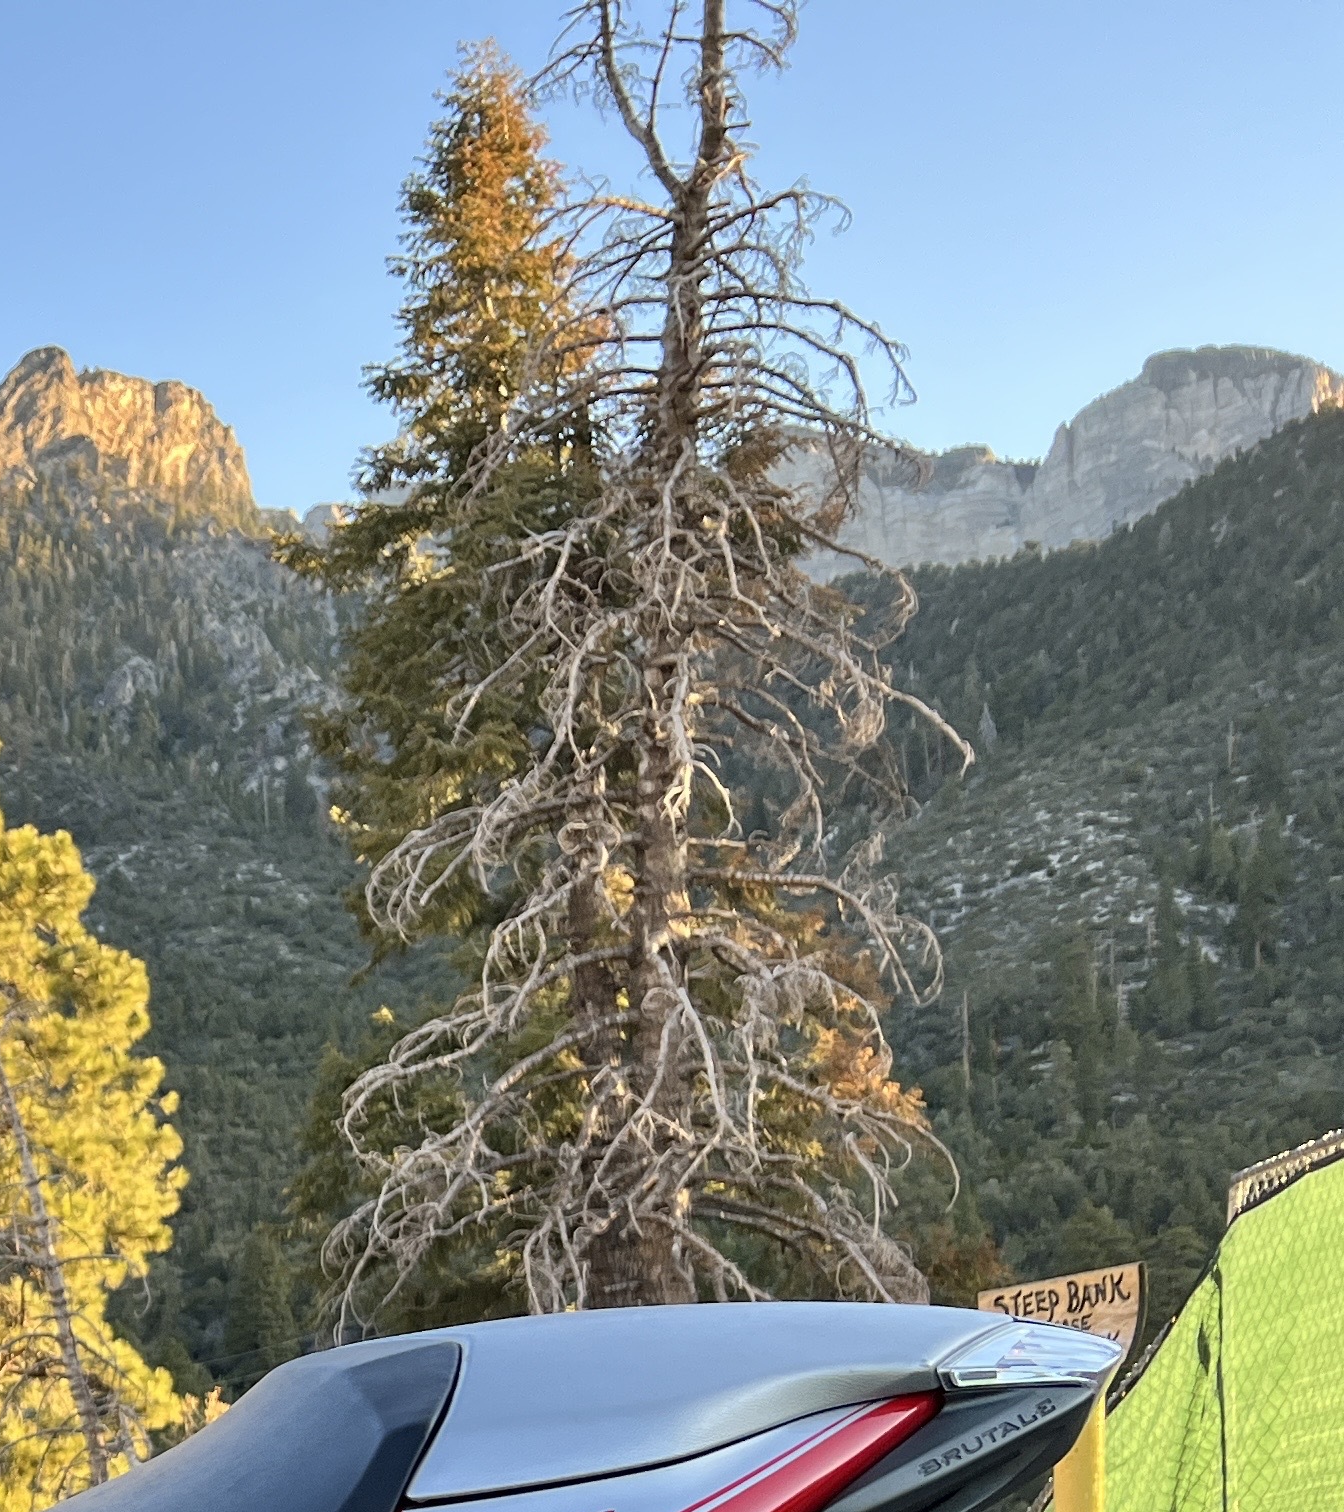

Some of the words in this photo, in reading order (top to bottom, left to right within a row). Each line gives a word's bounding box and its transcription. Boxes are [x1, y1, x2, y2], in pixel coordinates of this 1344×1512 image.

[994, 1289, 1060, 1322] STEEP
[1066, 1272, 1131, 1314] BANK
[918, 1397, 1057, 1477] BRUTALE
